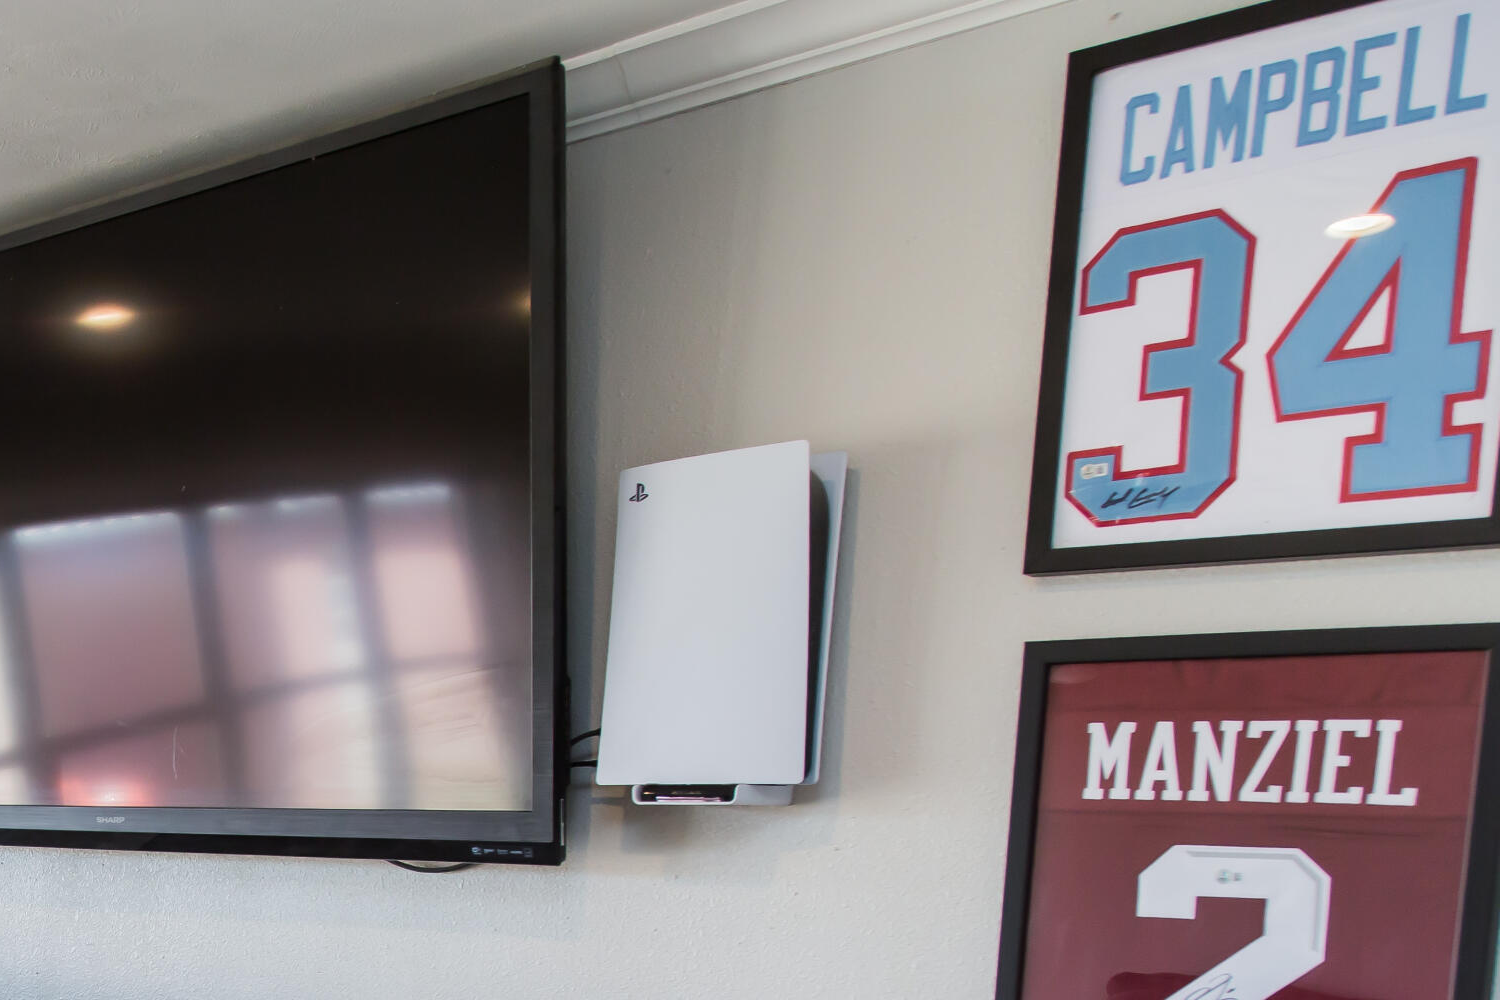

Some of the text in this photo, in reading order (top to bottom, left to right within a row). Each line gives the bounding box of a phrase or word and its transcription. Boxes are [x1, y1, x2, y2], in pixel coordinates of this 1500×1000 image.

[1118, 13, 1489, 186] CAMPBELL
[1064, 156, 1493, 528] 34
[96, 816, 126, 824] SHARP
[1082, 718, 1418, 806] MANZIEL
